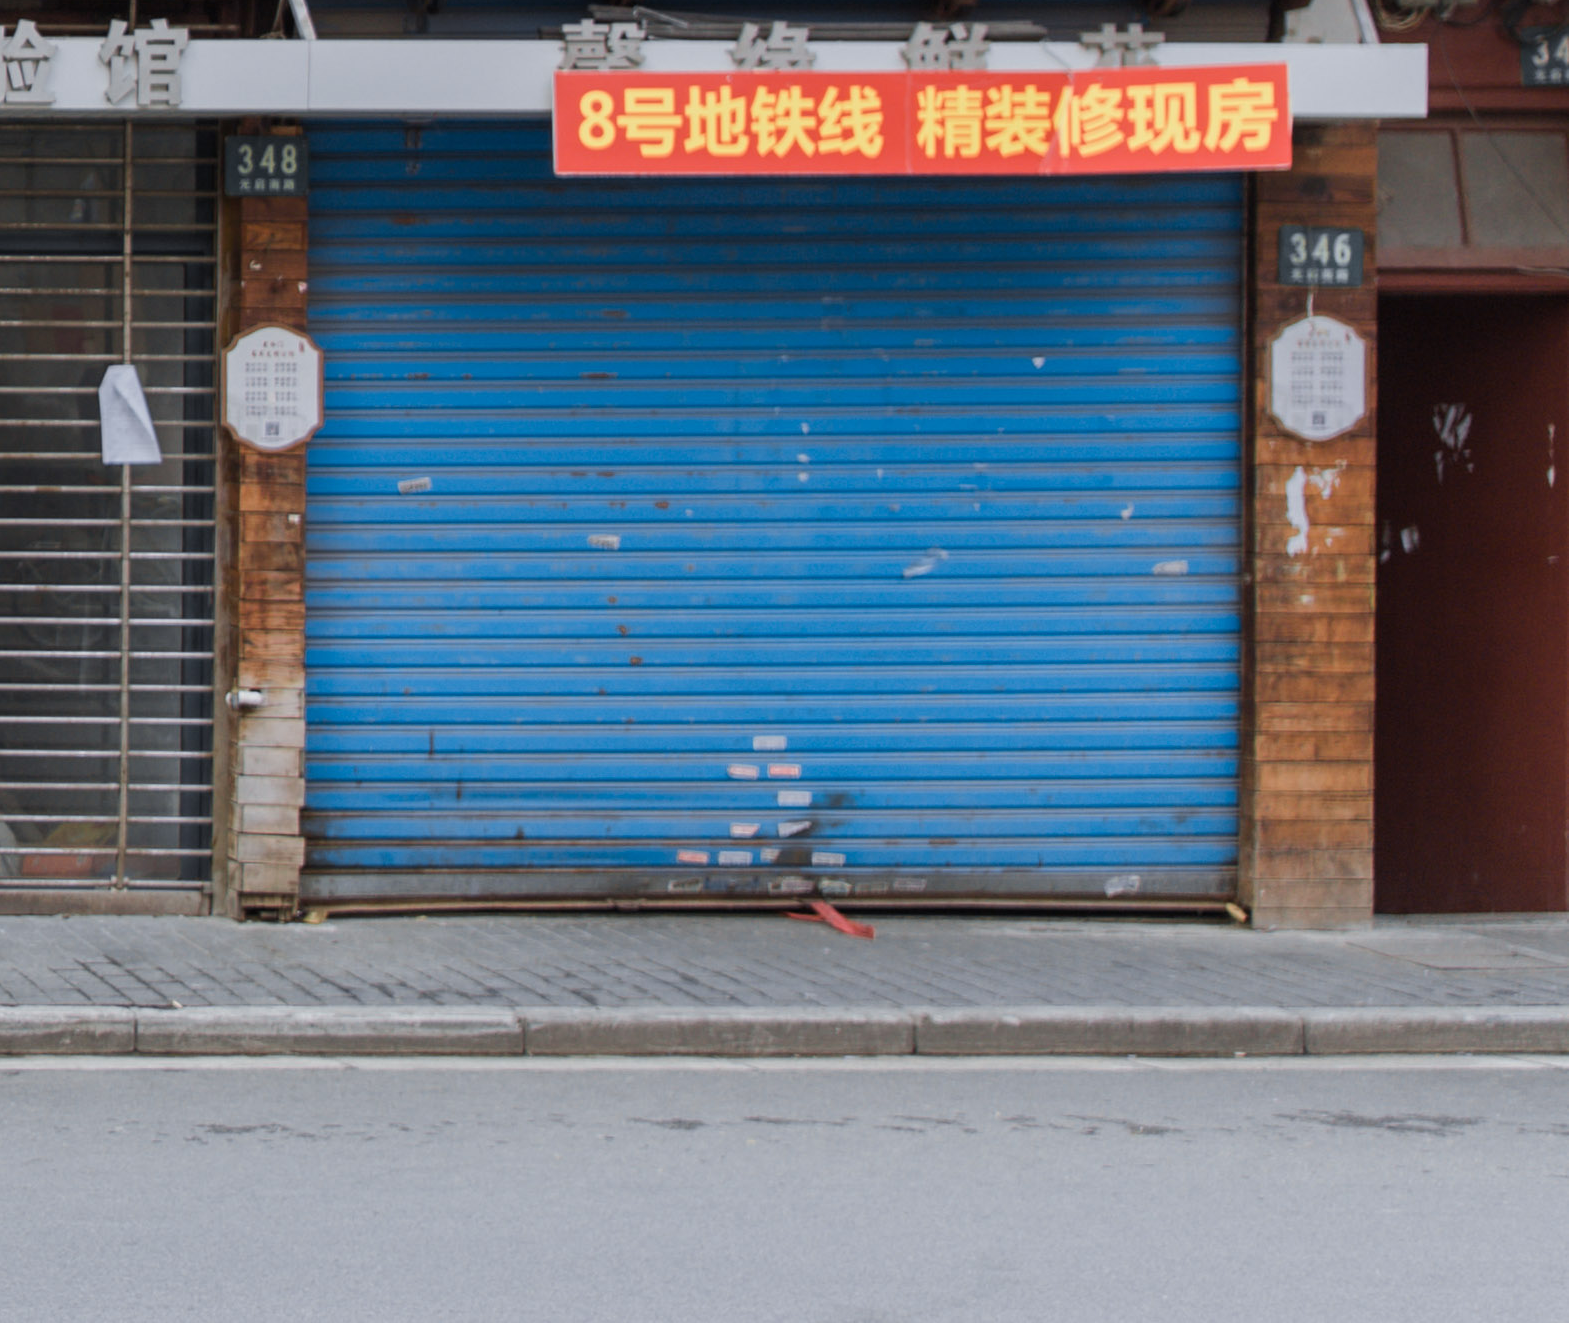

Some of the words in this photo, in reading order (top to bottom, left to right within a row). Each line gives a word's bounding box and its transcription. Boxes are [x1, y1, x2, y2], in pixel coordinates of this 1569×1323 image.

[578, 87, 884, 159] 8号地铁线
[917, 78, 1278, 159] 精装修现房
[237, 144, 297, 174] 348
[1289, 233, 1351, 266] 346
